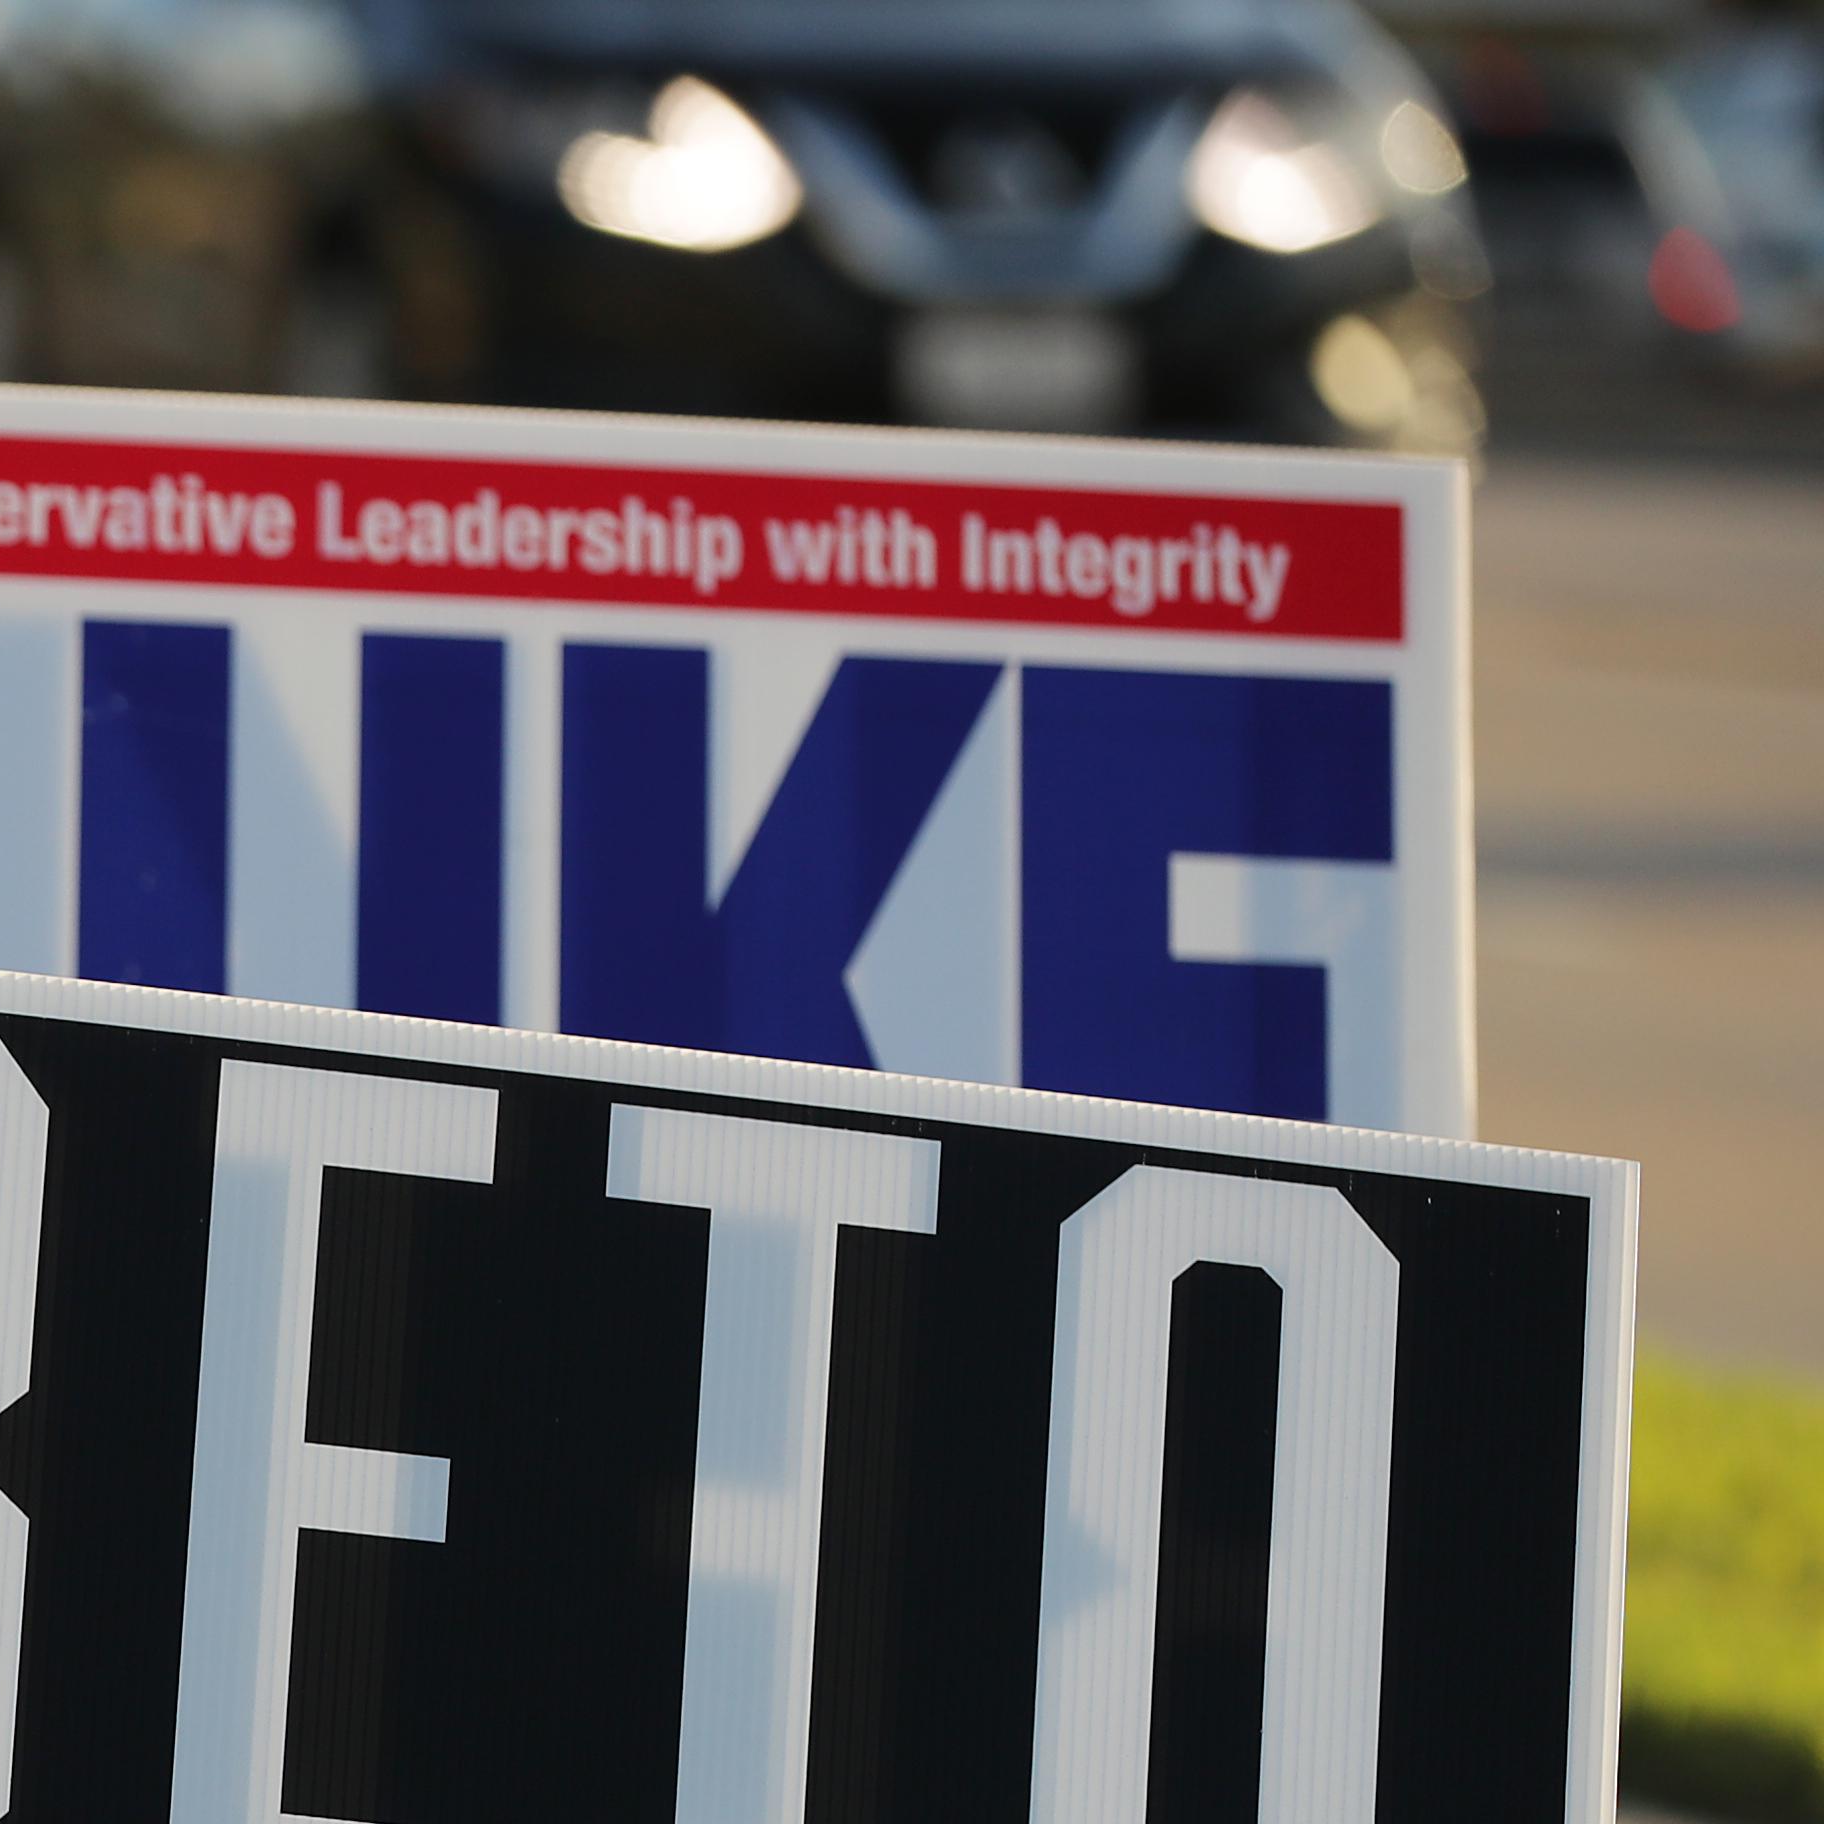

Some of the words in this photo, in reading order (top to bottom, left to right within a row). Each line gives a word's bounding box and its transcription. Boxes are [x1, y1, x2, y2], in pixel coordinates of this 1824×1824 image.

[318, 480, 742, 596] Leadership
[765, 506, 939, 591] with
[961, 514, 1289, 622] Integrity
